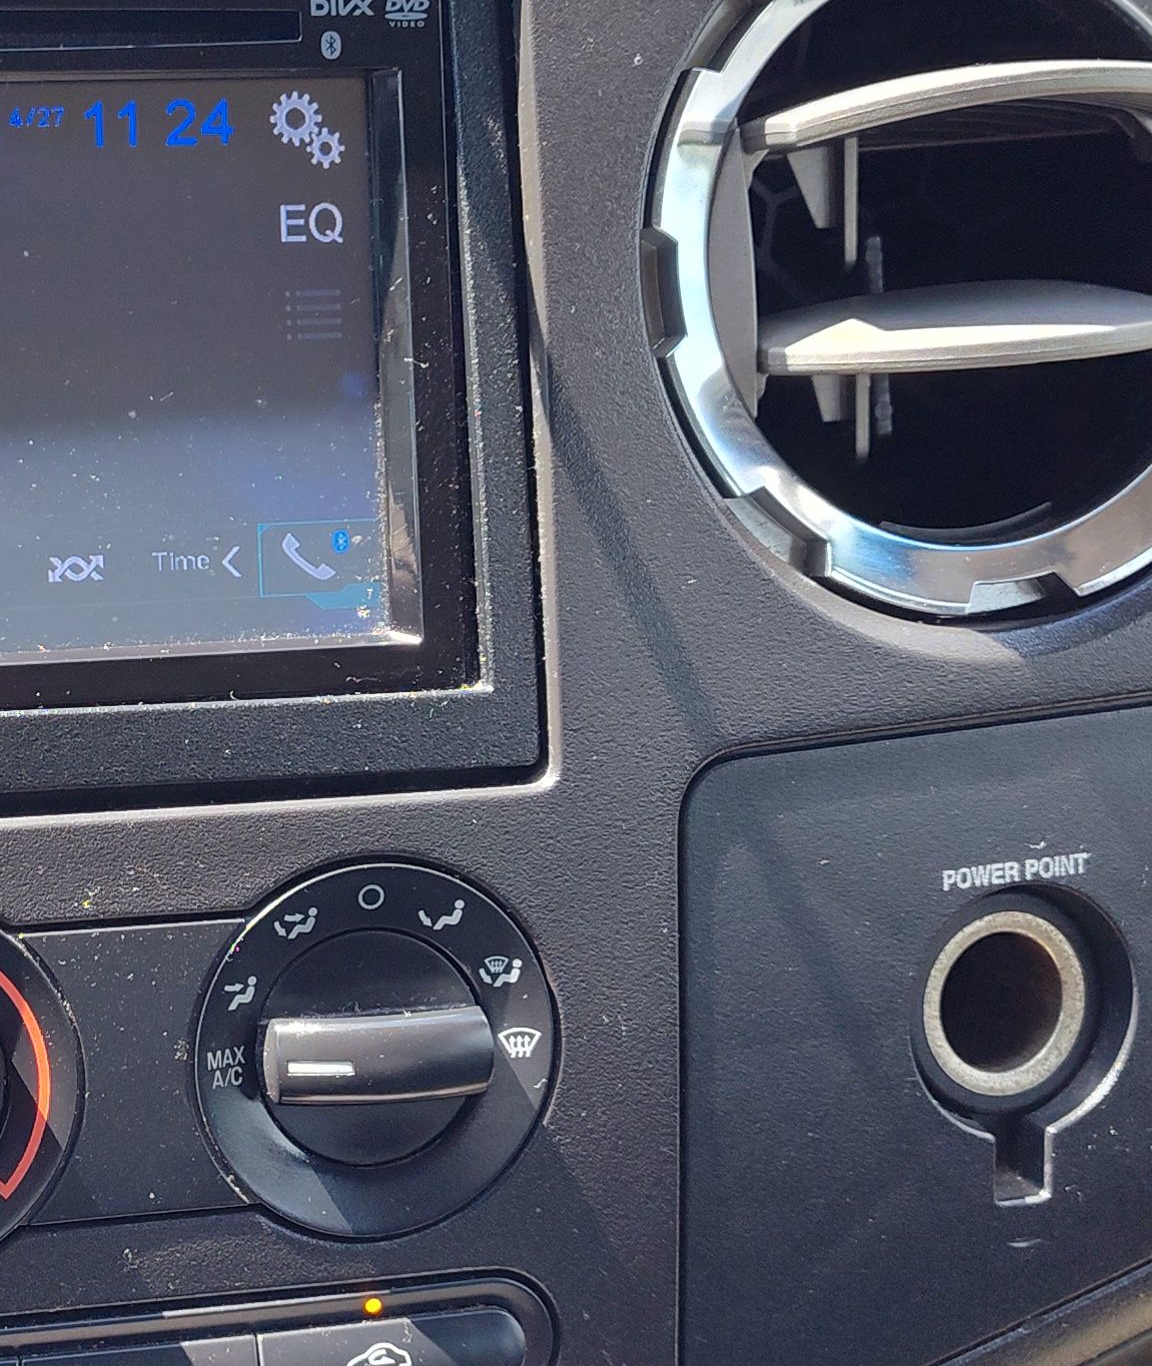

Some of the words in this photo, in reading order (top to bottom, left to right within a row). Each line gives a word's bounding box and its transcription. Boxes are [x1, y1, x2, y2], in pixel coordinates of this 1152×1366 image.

[280, 204, 343, 244] EQ
[152, 551, 209, 572] Time
[942, 861, 1021, 892] POWER
[1024, 852, 1091, 881] POINT
[206, 1044, 246, 1068] MAX
[212, 1065, 244, 1088] A/C
